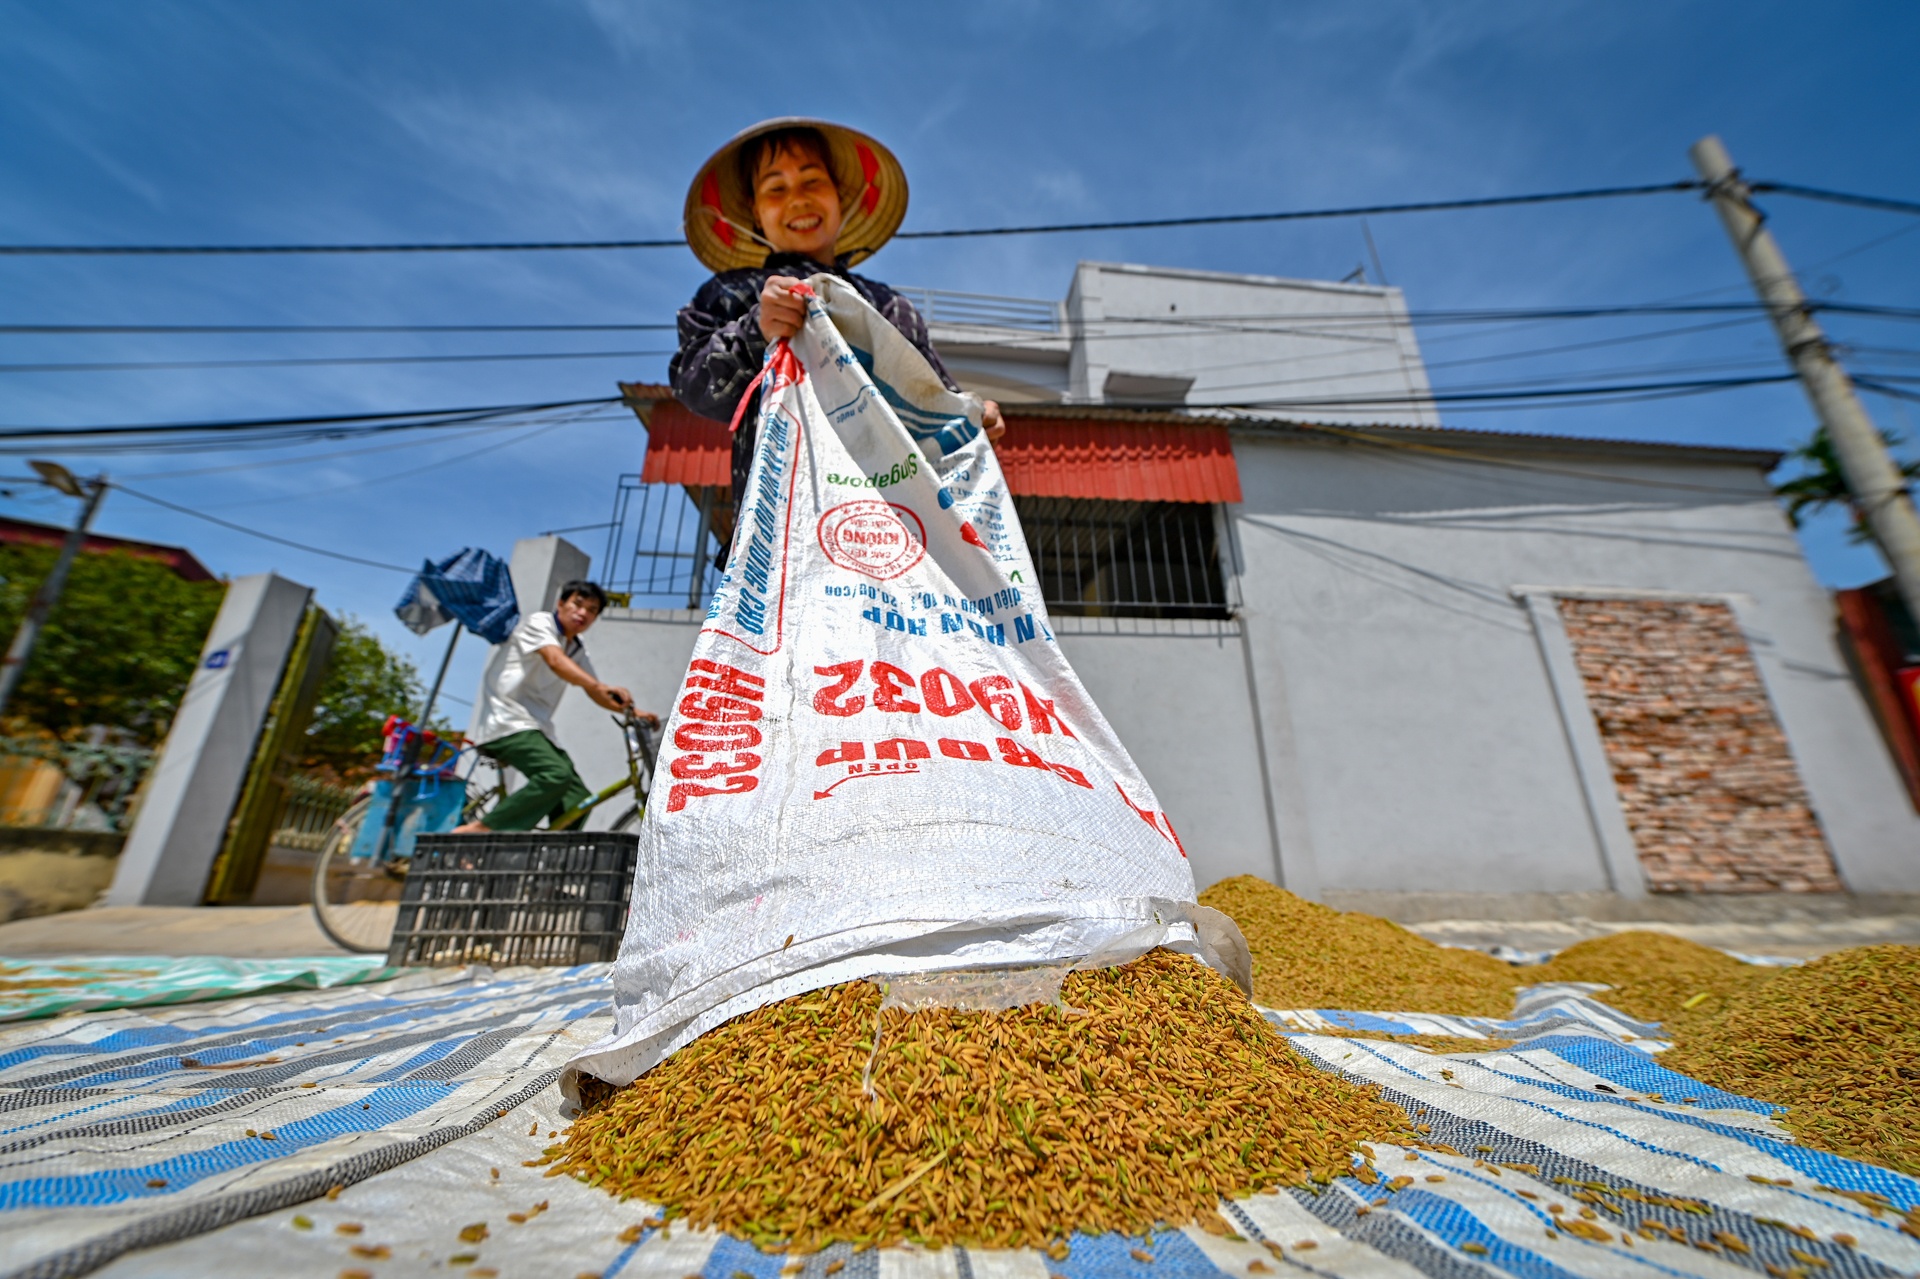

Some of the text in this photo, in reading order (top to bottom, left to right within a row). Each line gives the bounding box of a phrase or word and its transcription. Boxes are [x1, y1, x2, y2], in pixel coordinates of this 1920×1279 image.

[826, 452, 918, 489] Singapore
[843, 529, 899, 547] KHÔNG
[743, 534, 776, 594] DÙNG
[734, 587, 766, 635] CHO
[862, 606, 927, 637] HỢP
[813, 658, 1078, 742] H9032
[665, 658, 766, 813] H9032
[815, 737, 1093, 789] GROUP
[847, 761, 917, 774] OPEN
